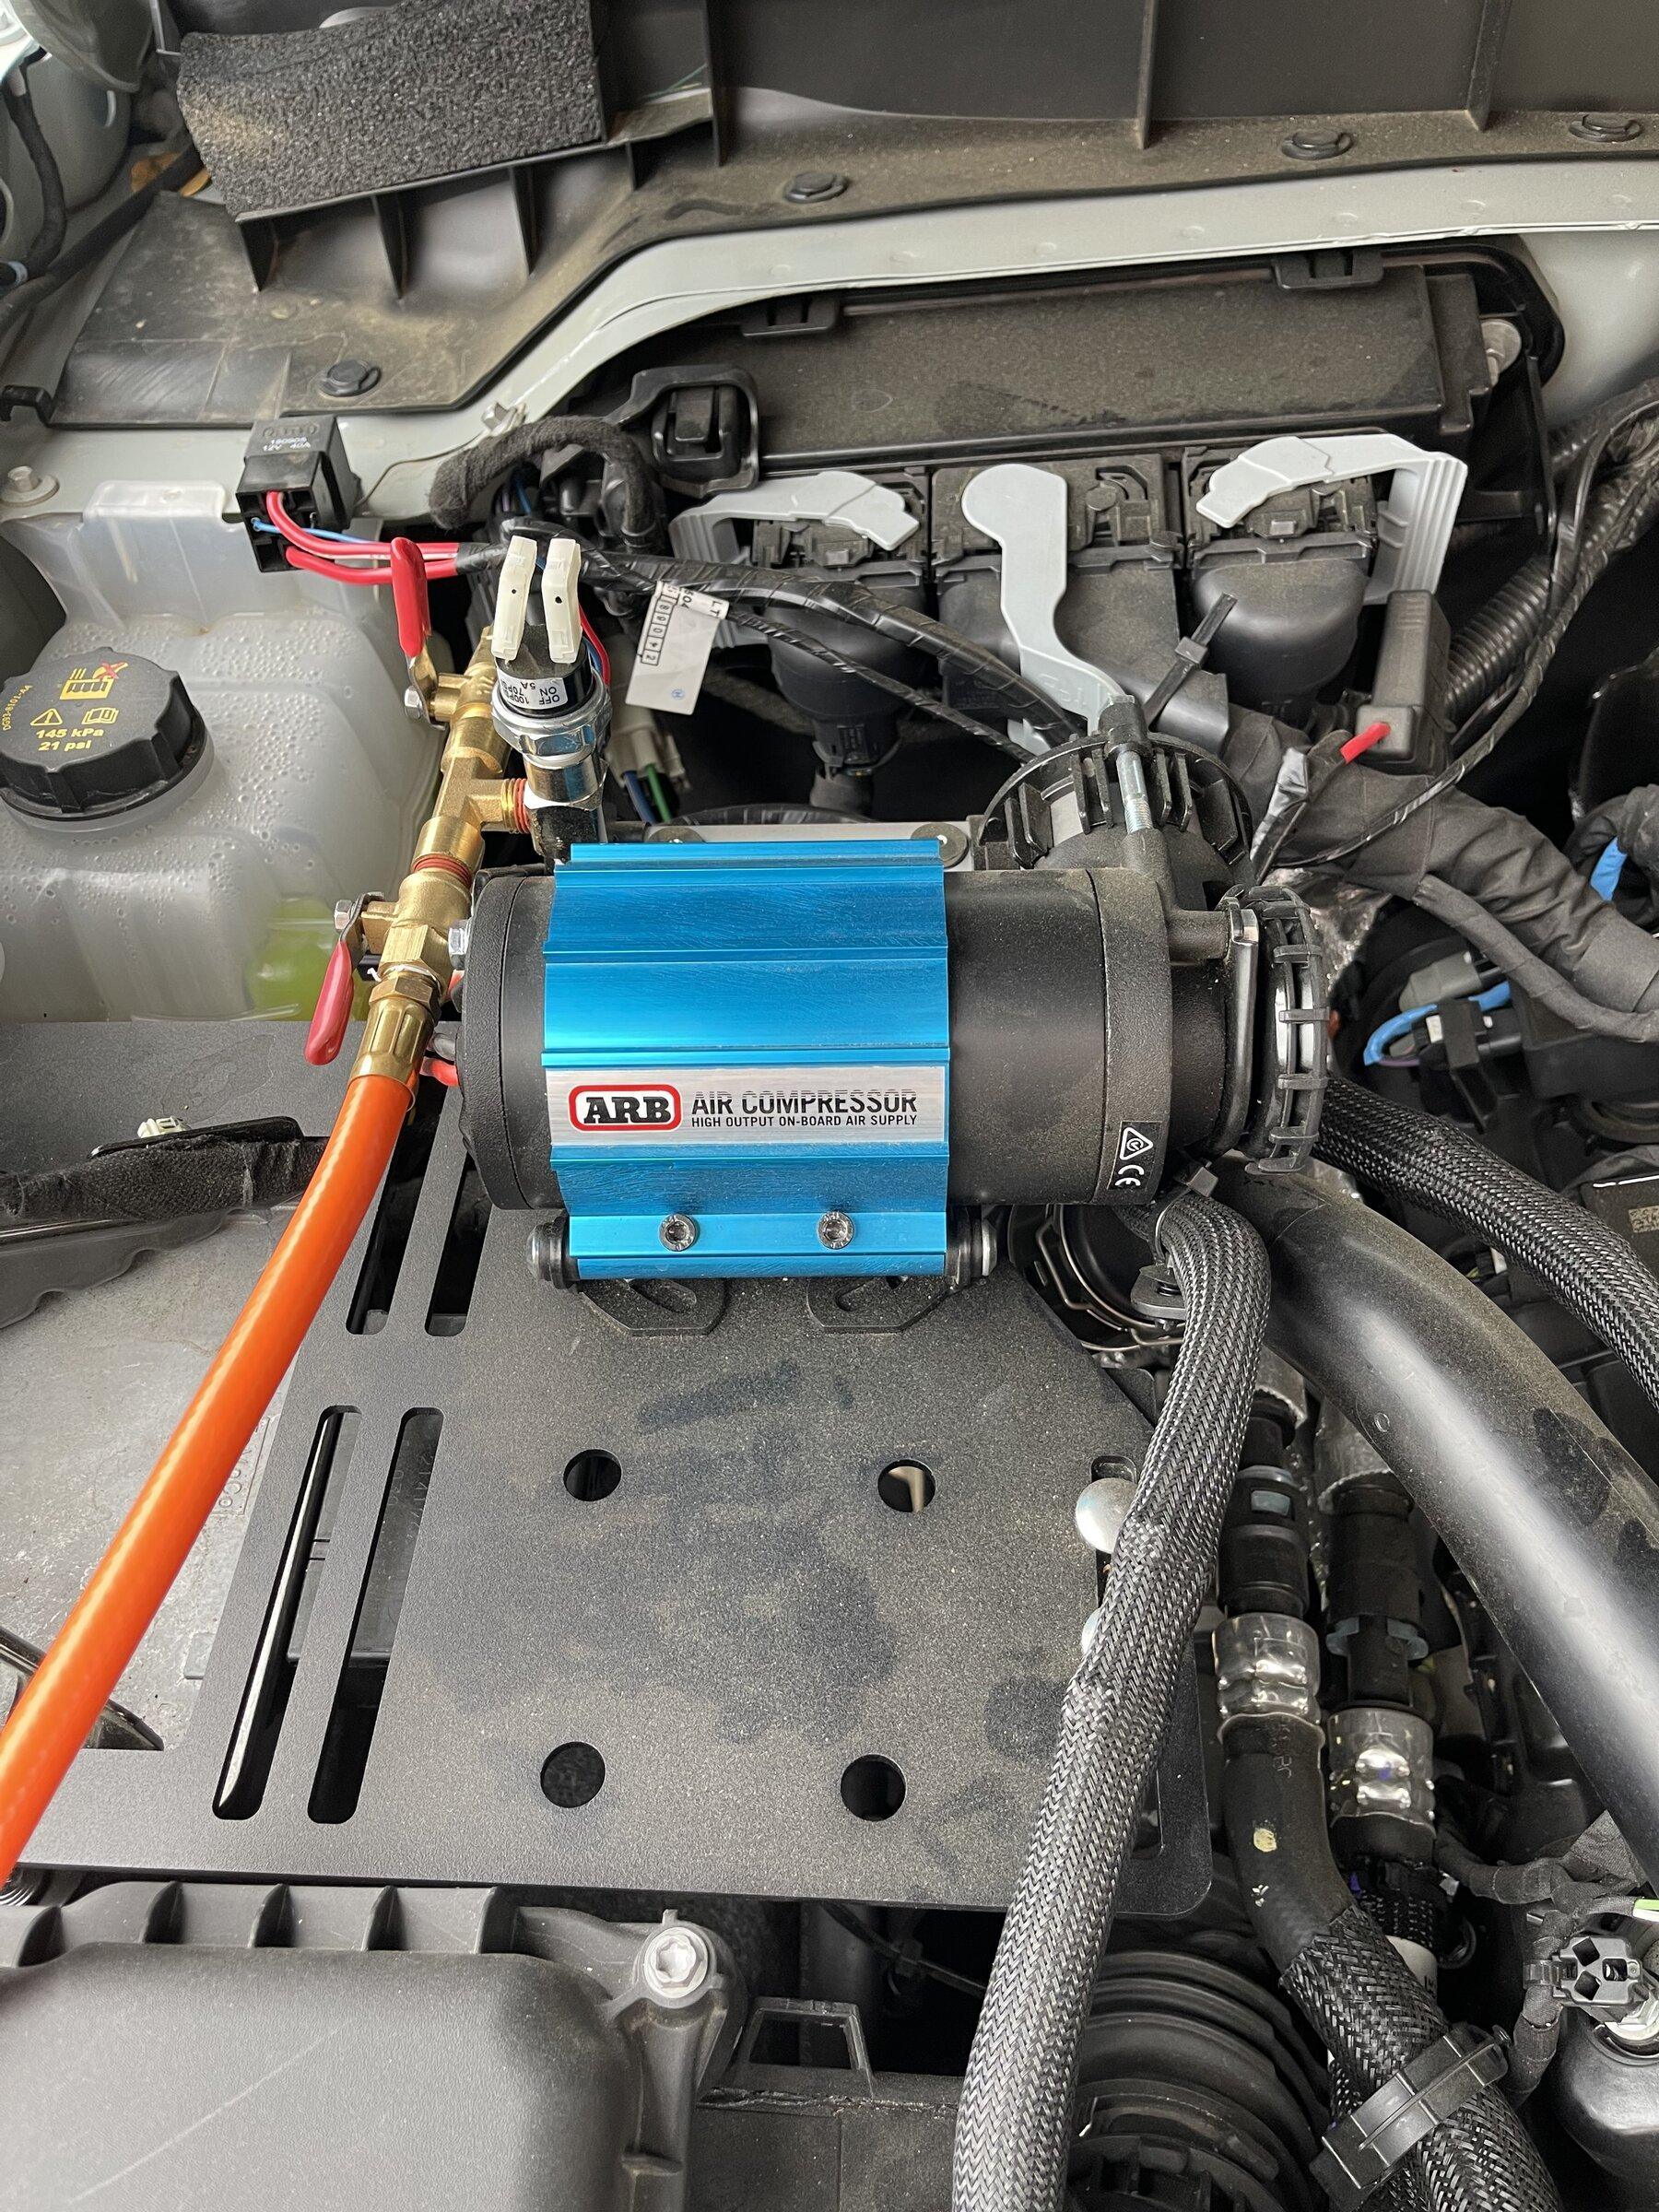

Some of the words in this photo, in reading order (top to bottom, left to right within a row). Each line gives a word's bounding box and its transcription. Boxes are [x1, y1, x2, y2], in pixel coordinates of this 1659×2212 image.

[539, 686, 557, 697] ON
[538, 694, 560, 705] OFF
[36, 729, 67, 738] 145
[71, 728, 104, 737] kPa
[39, 742, 60, 751] 21
[65, 740, 91, 751] psi
[691, 1090, 734, 1115] AIR
[742, 1088, 917, 1114] COMPRESSOR
[583, 1096, 672, 1124] ARB
[691, 1116, 724, 1127] HIGH
[726, 1116, 775, 1127] OUTPUT
[779, 1115, 841, 1127] ON-BOARD
[846, 1115, 867, 1126] AIR
[871, 1114, 917, 1126] SUPPLY
